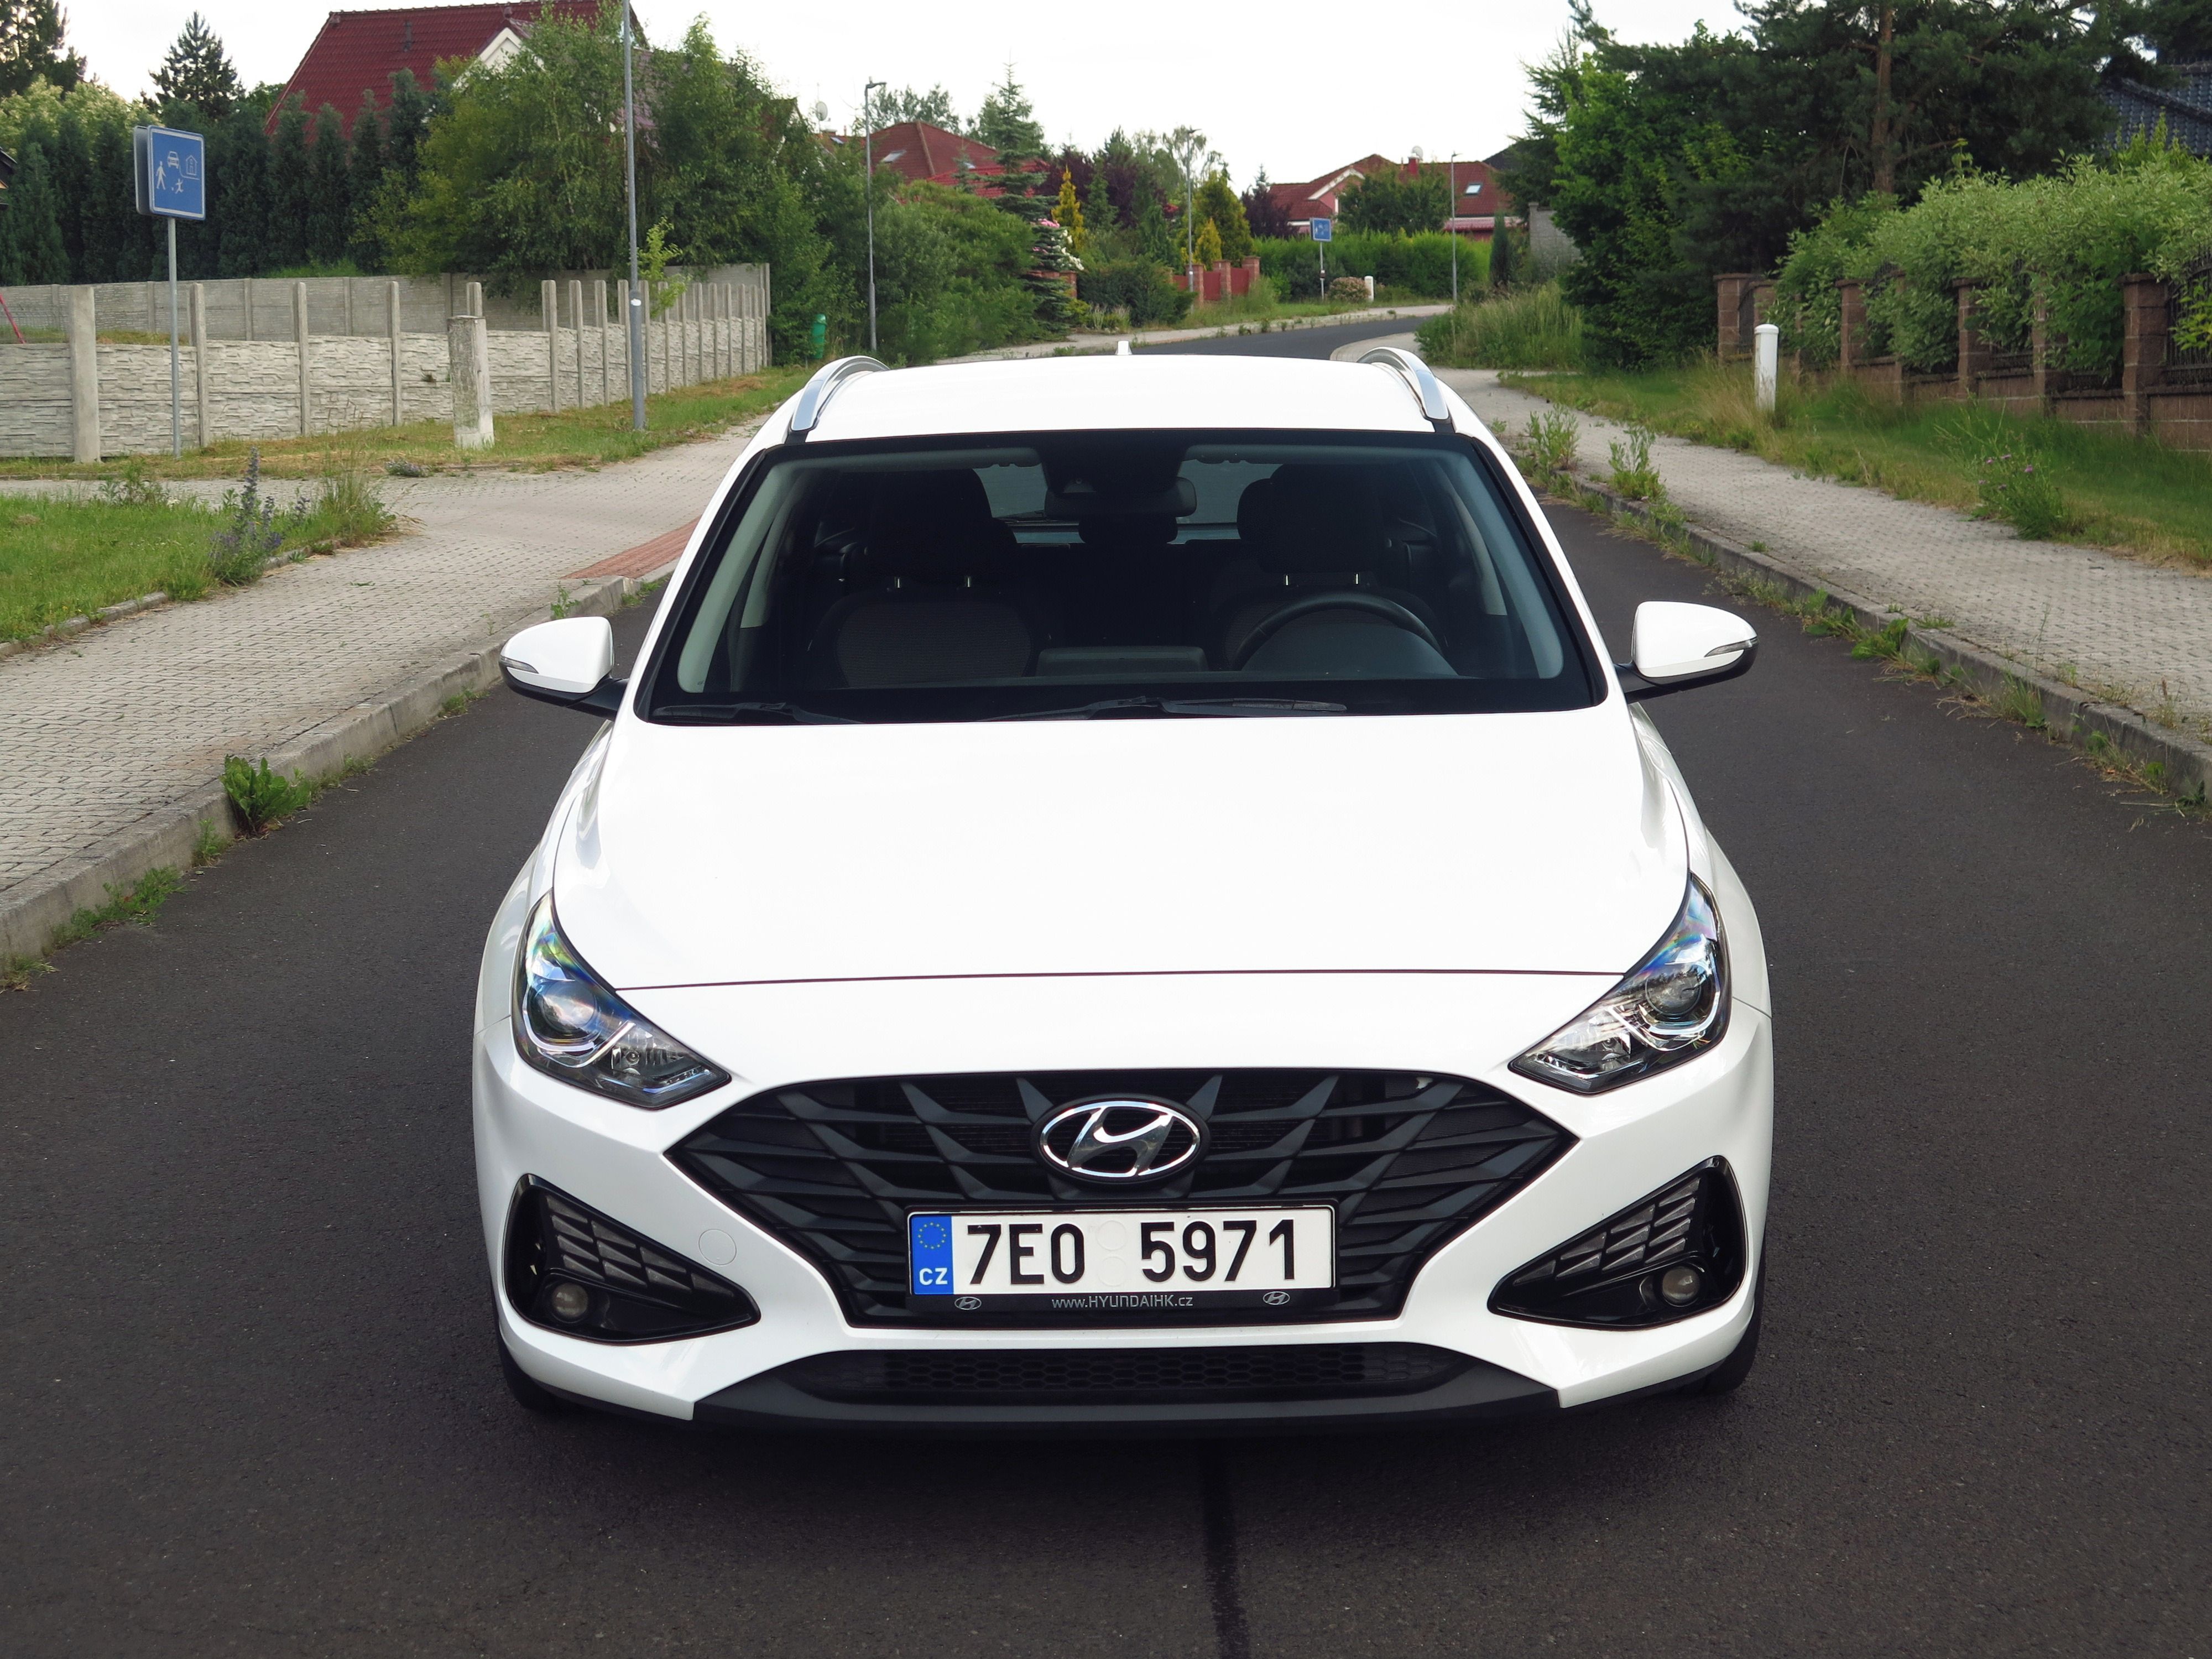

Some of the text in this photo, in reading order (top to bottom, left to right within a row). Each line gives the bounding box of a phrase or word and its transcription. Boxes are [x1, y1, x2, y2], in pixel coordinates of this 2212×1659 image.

[967, 1219, 1295, 1285] 7E0 5971
[919, 1267, 948, 1285] CZ
